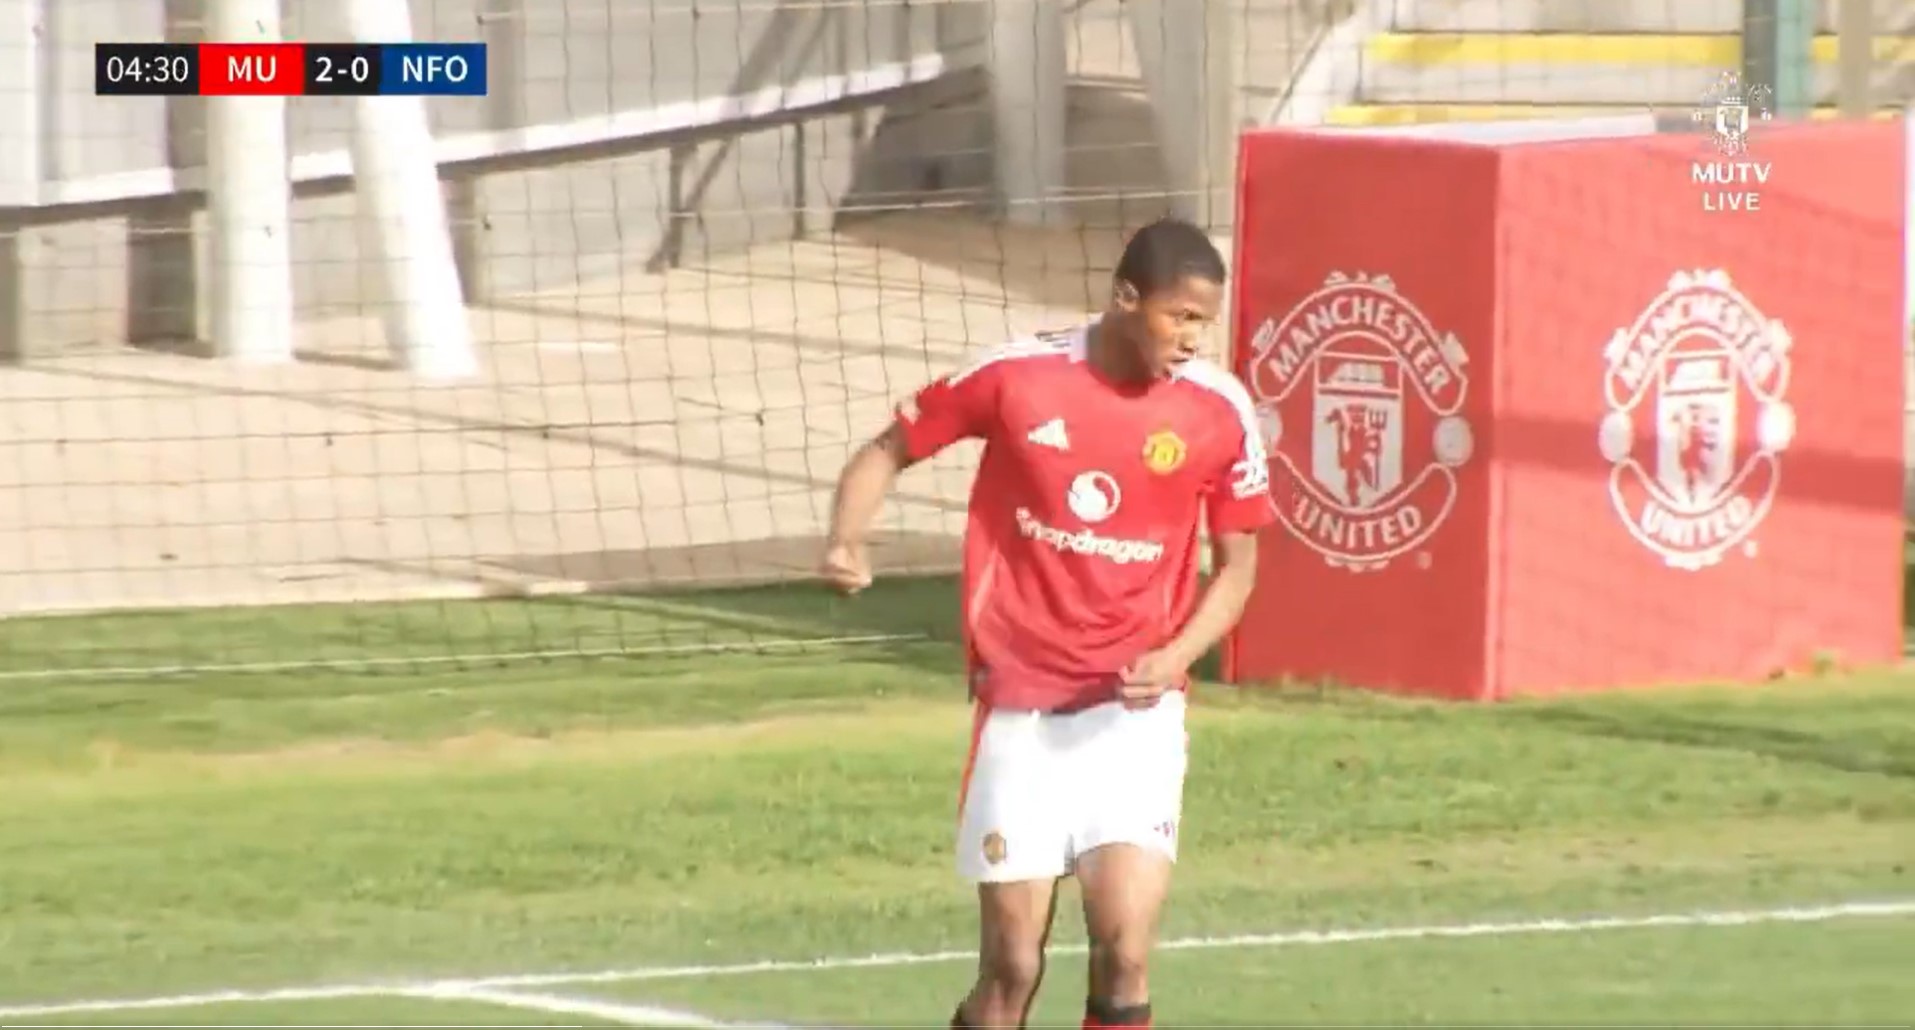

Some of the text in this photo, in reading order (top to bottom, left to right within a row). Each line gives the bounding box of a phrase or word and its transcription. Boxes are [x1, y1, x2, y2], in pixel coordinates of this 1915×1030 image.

[1269, 296, 1450, 394] MANCHESTER
[1293, 497, 1422, 548] UNITED
[1640, 496, 1750, 546] UNITED
